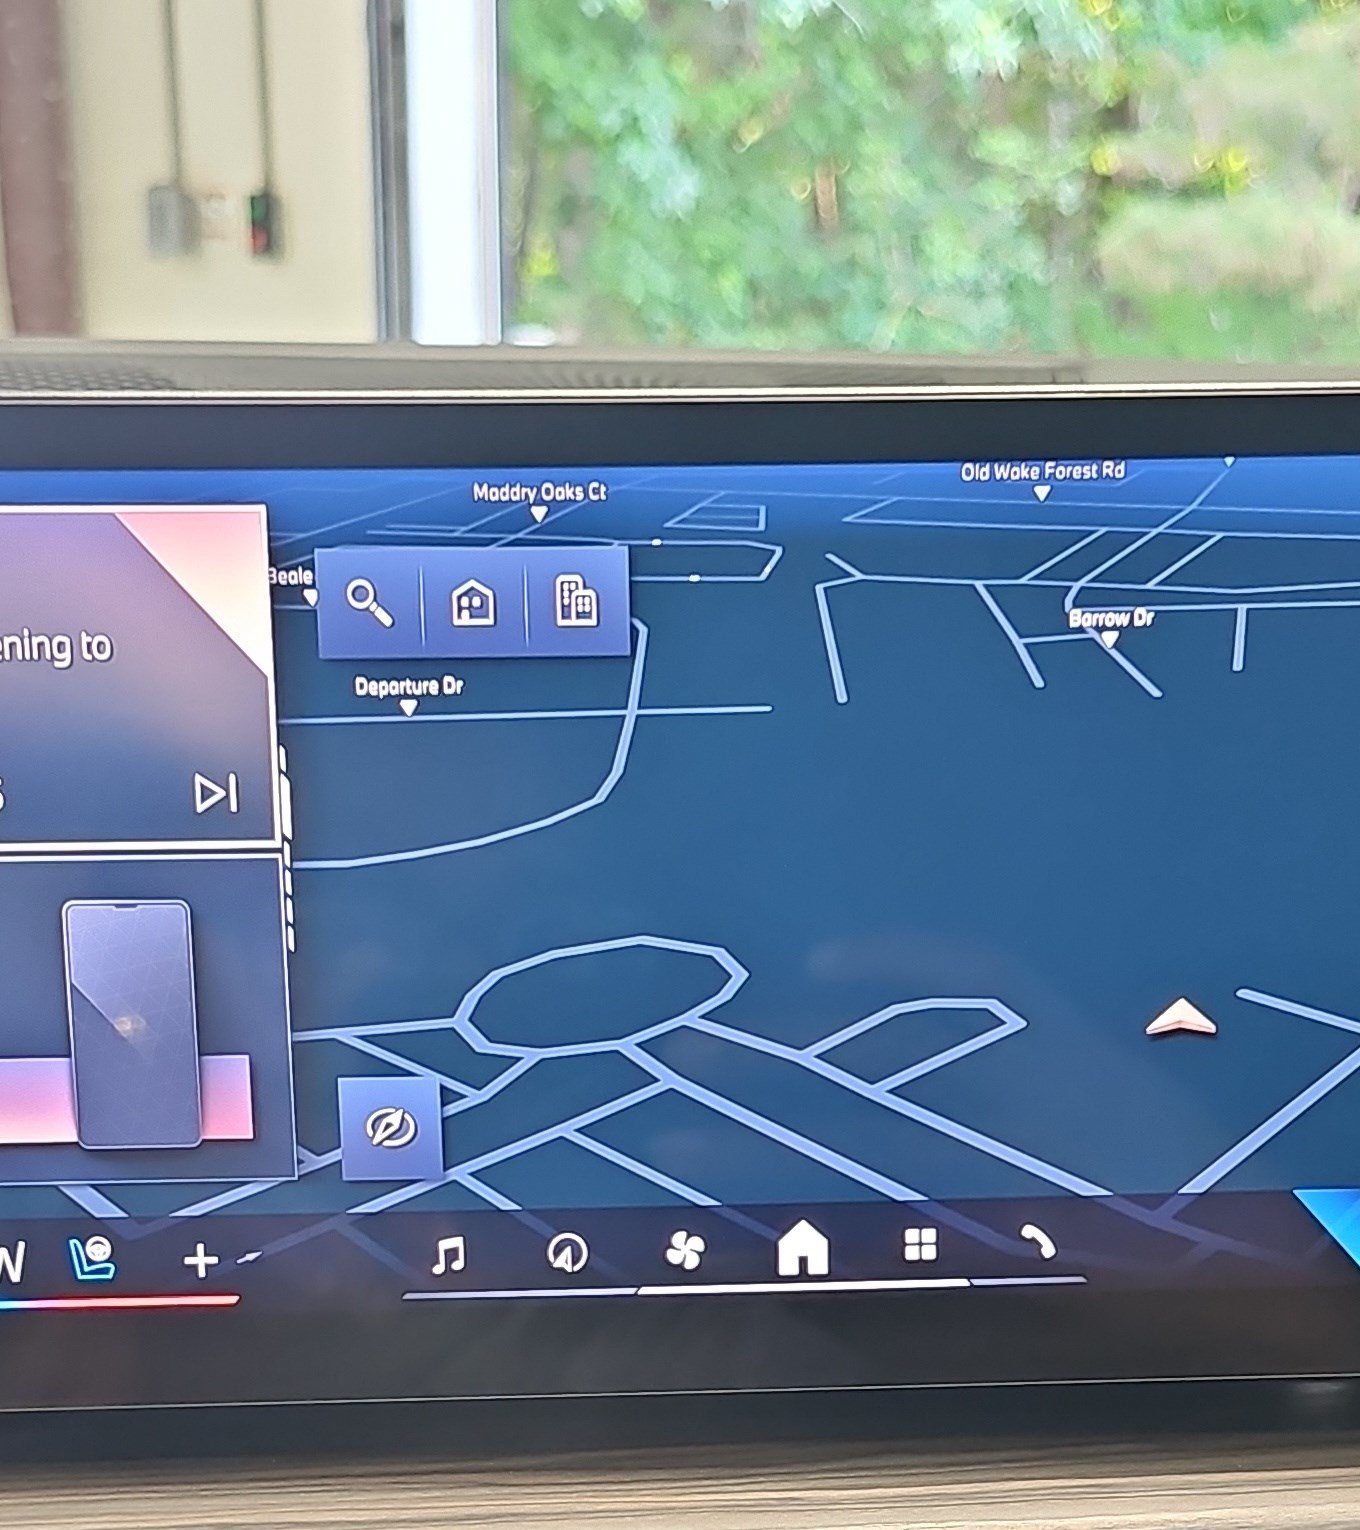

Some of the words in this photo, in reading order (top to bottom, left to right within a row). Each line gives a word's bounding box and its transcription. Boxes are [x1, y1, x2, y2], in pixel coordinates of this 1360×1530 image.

[961, 462, 990, 482] Old
[993, 462, 1040, 482] Wake
[1044, 462, 1099, 481] Forest
[1102, 460, 1126, 480] Rd
[473, 481, 538, 505] Maddry
[541, 481, 584, 502] Oaks
[588, 481, 607, 502] Ct
[268, 565, 313, 586] Beale
[1068, 609, 1129, 629] Barrow
[1133, 608, 1155, 628] Dr
[81, 629, 113, 662] to
[355, 676, 439, 700] Departure
[443, 675, 464, 696] Dr
